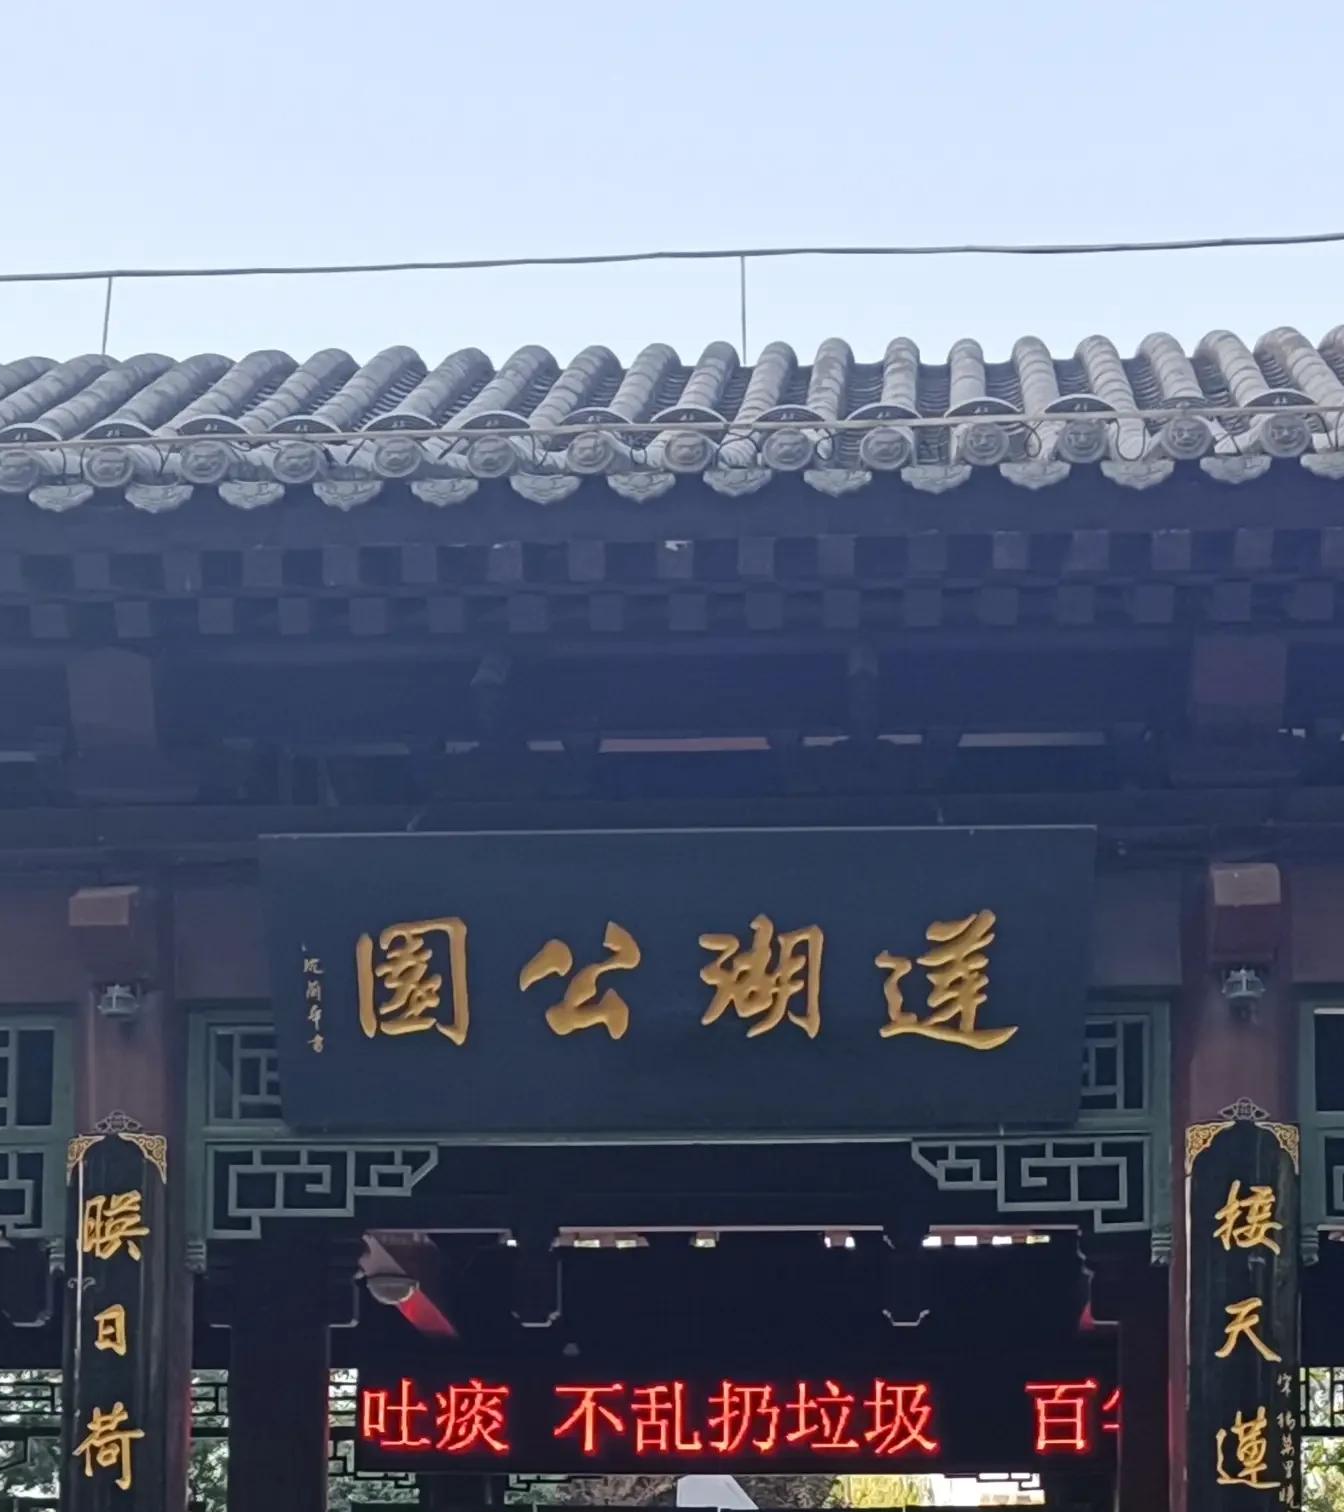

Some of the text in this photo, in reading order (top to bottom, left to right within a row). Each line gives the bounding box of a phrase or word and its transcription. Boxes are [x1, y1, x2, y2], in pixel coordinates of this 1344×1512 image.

[362, 1379, 510, 1453] 吐痰
[553, 1379, 938, 1455] 不乱扔垃圾
